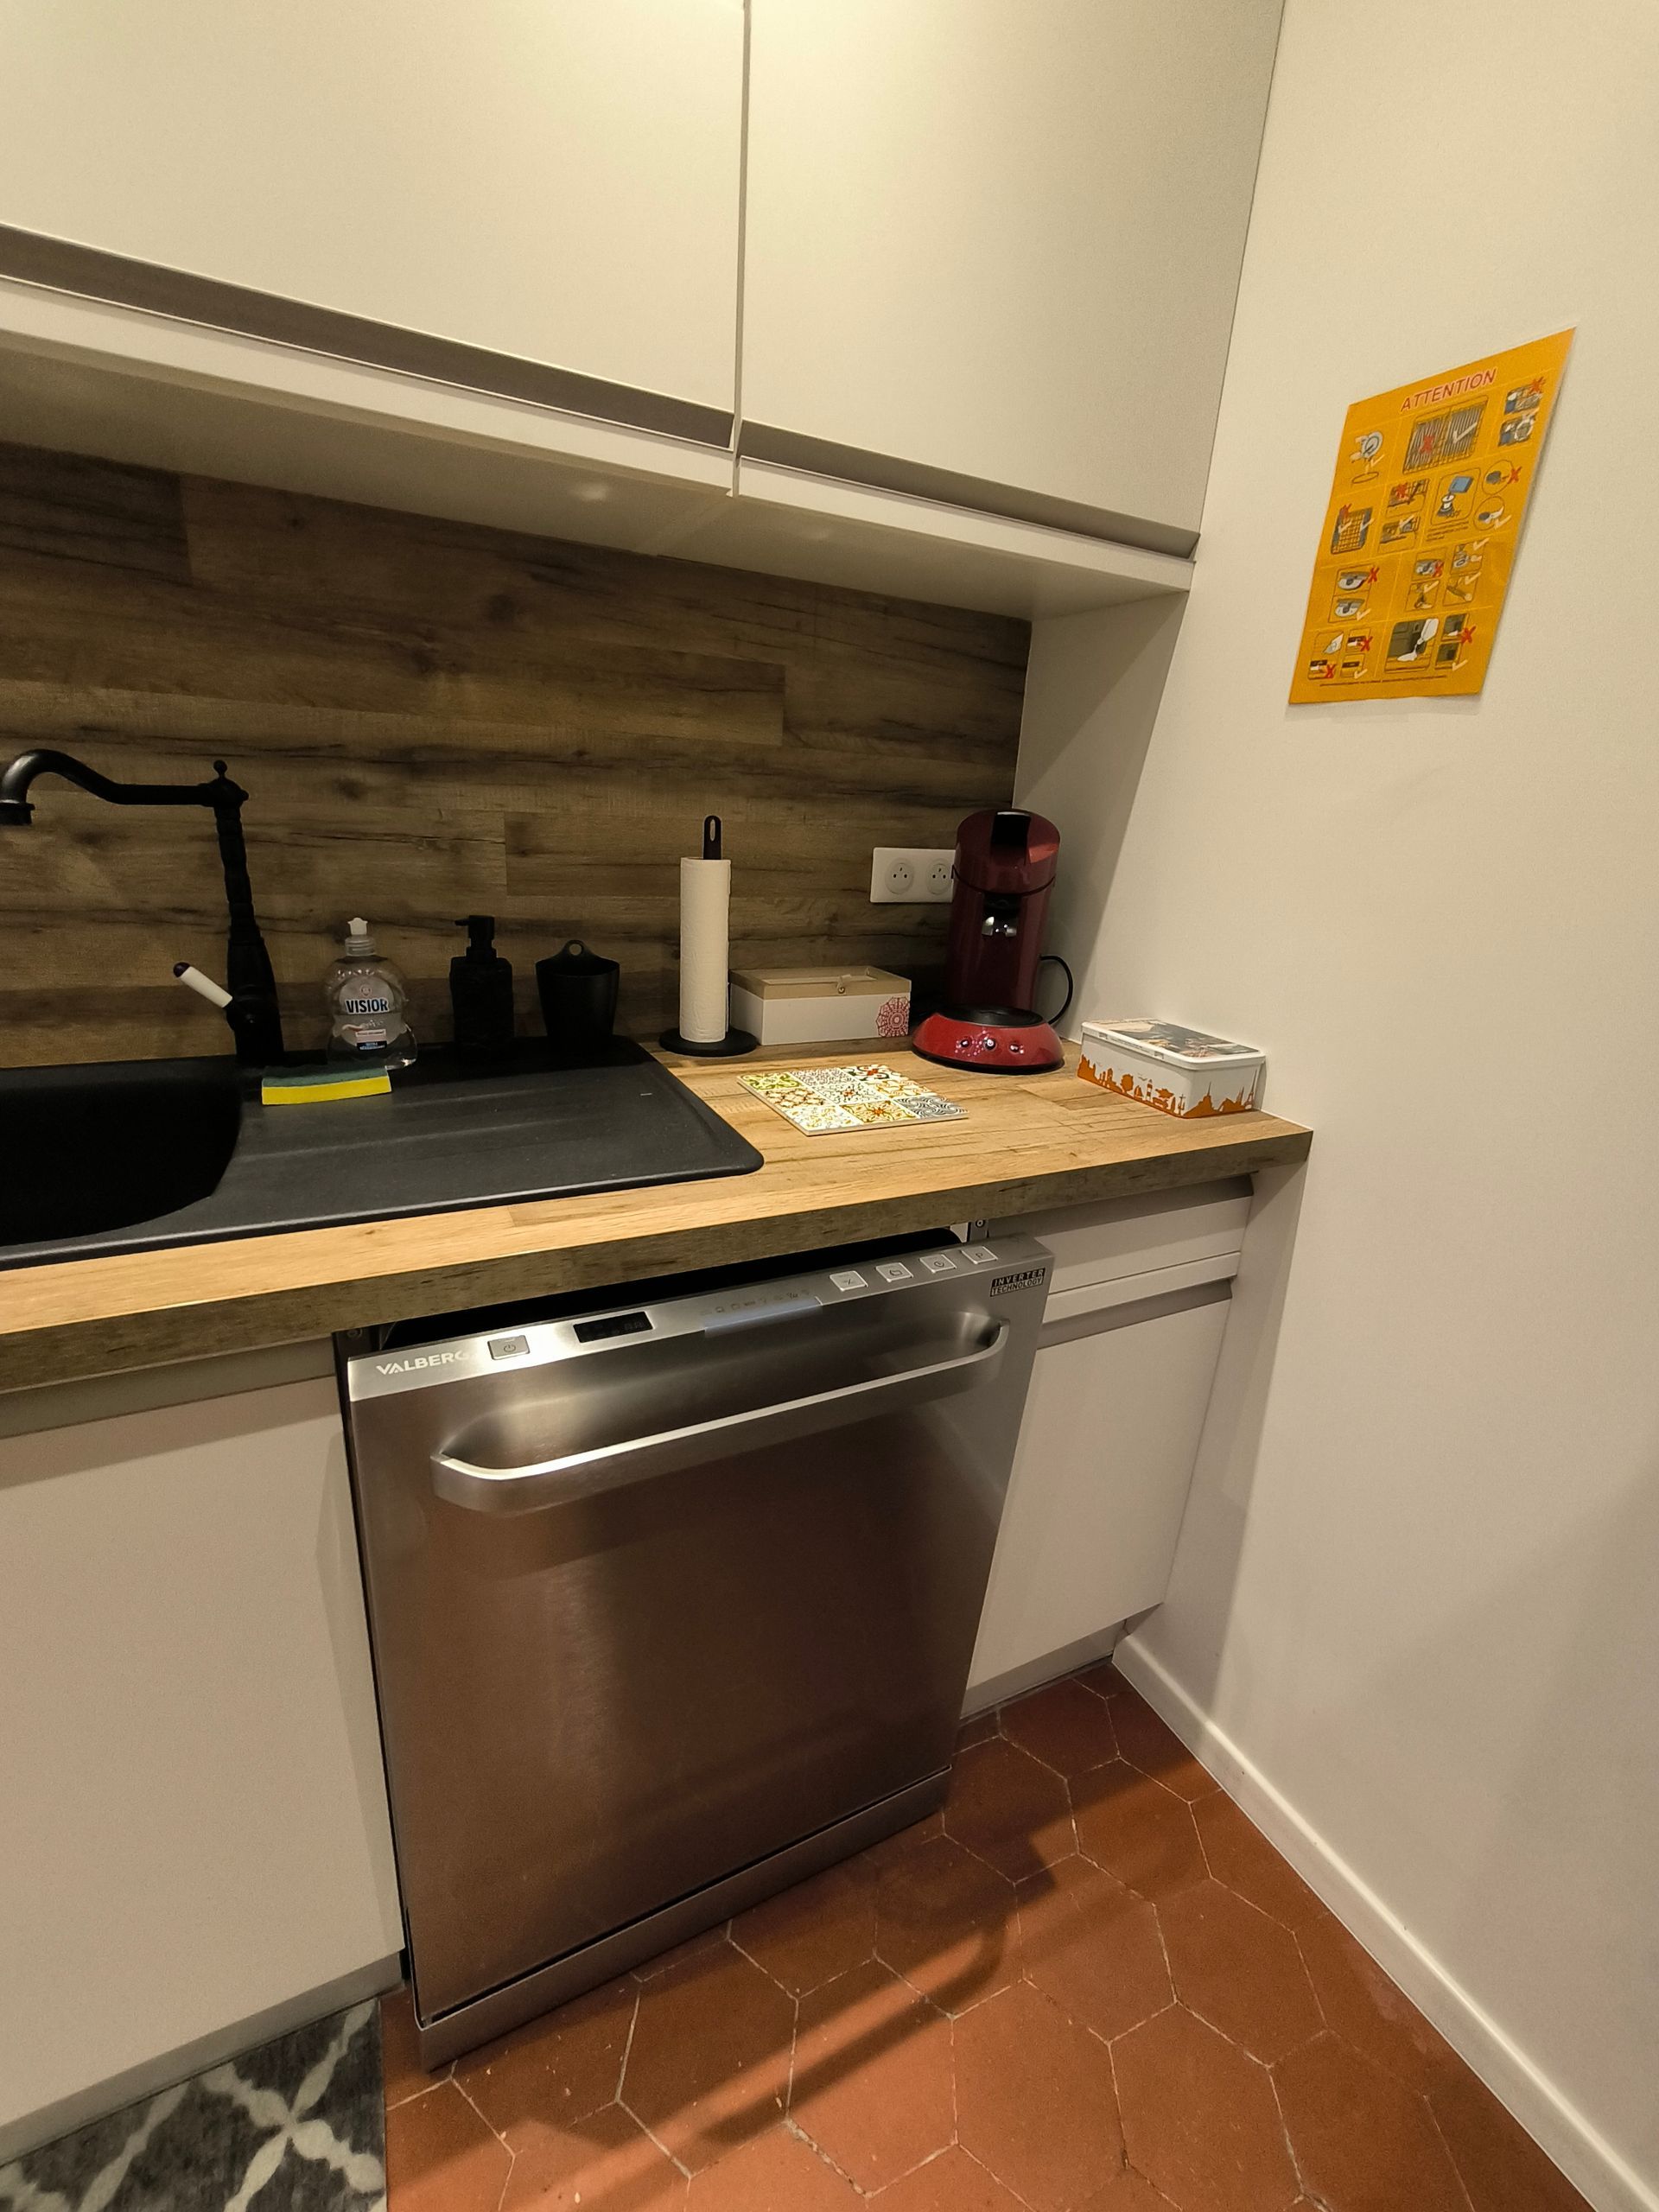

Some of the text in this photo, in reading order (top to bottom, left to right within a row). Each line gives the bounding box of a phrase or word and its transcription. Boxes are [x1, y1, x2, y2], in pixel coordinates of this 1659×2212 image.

[1400, 368, 1497, 412] ATTENTION
[346, 999, 389, 1014] VISIOR
[992, 1276, 1043, 1295] TECHNOLOGY
[995, 1268, 1044, 1287] INVERTER
[376, 1350, 471, 1375] VALBERG
